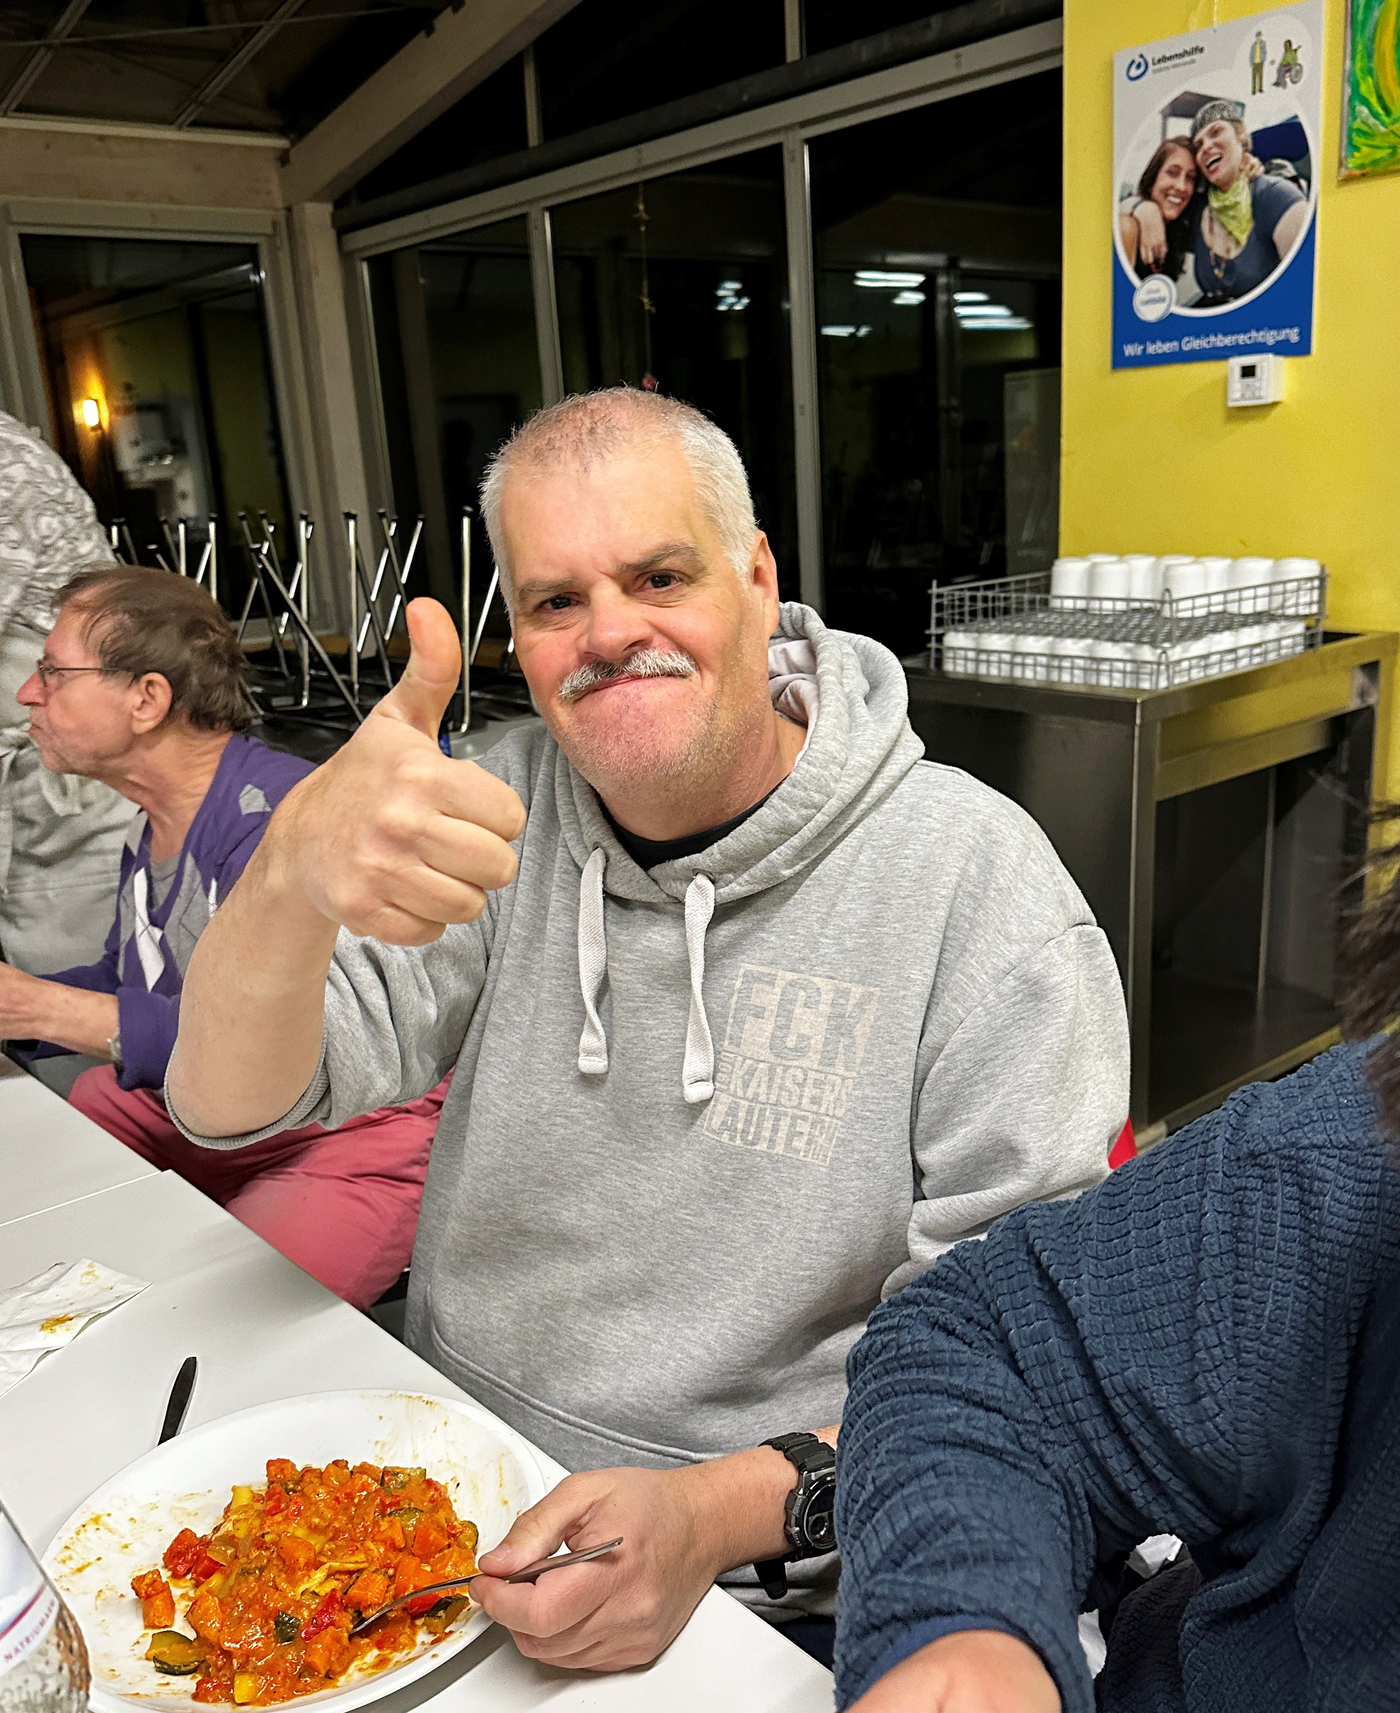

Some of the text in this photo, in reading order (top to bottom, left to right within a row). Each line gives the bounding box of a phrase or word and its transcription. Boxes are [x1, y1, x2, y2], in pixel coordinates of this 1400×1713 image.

[1123, 326, 1301, 357] Wir leben Gleichberechtigung
[726, 966, 880, 1071] FCK
[729, 1057, 854, 1118] KAISERS
